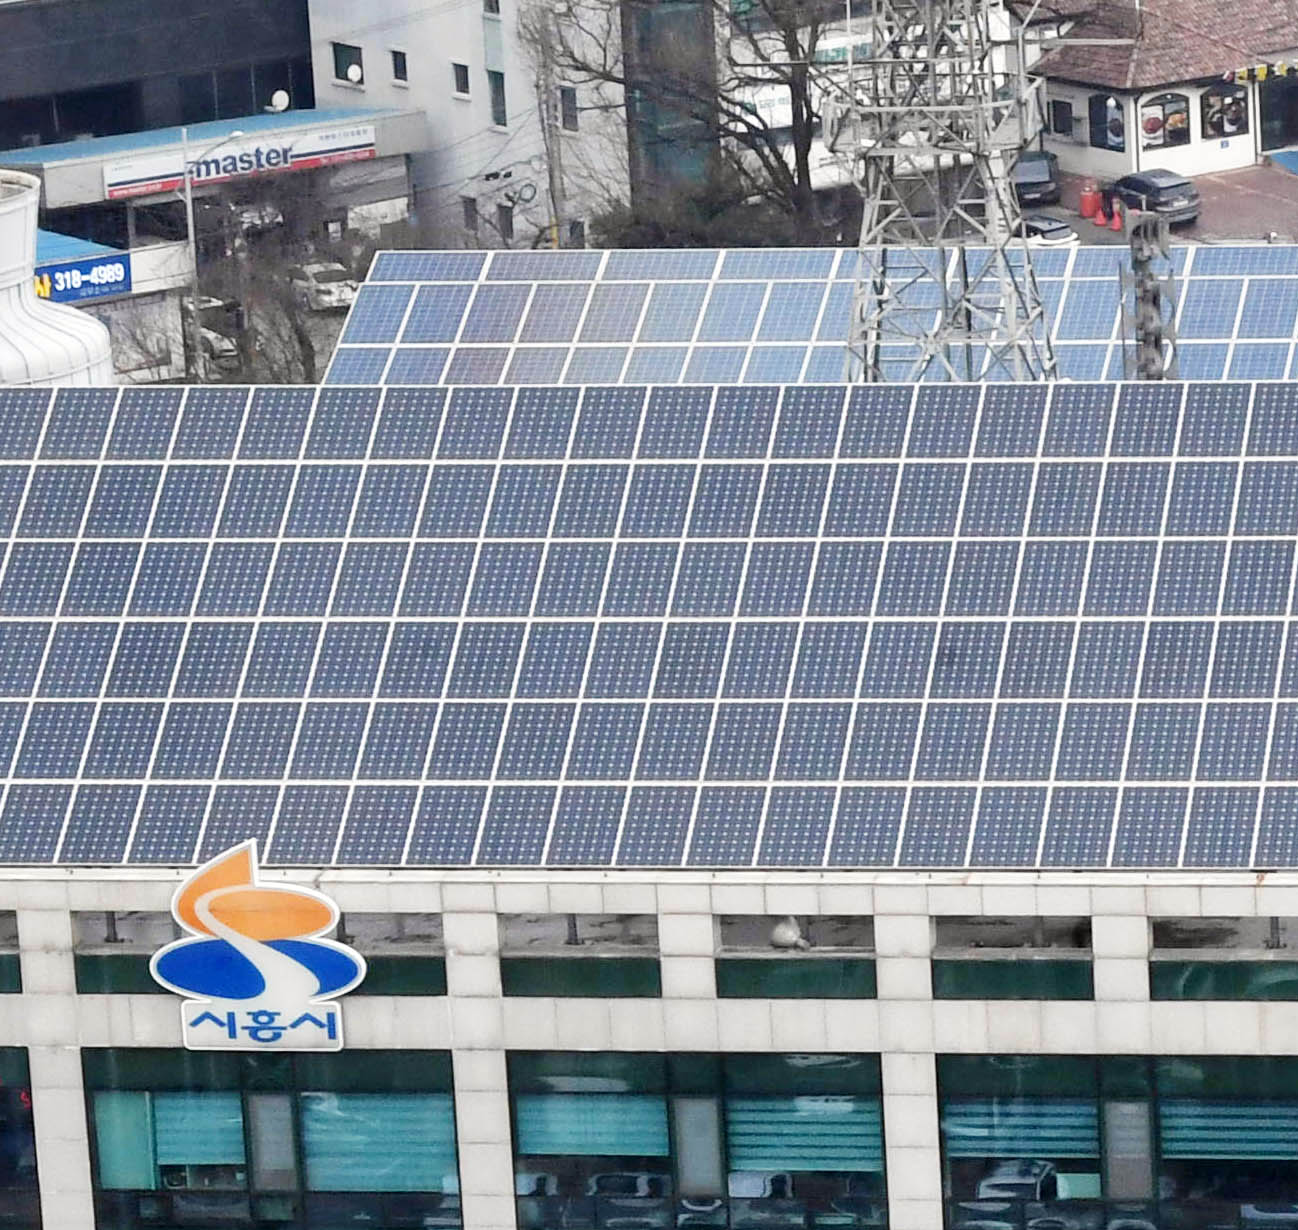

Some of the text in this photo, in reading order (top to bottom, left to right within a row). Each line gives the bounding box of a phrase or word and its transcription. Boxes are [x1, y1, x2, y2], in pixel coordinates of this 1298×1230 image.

[196, 145, 293, 178] master
[54, 263, 125, 292] 318-4989
[190, 1009, 338, 1043] 시흥시
